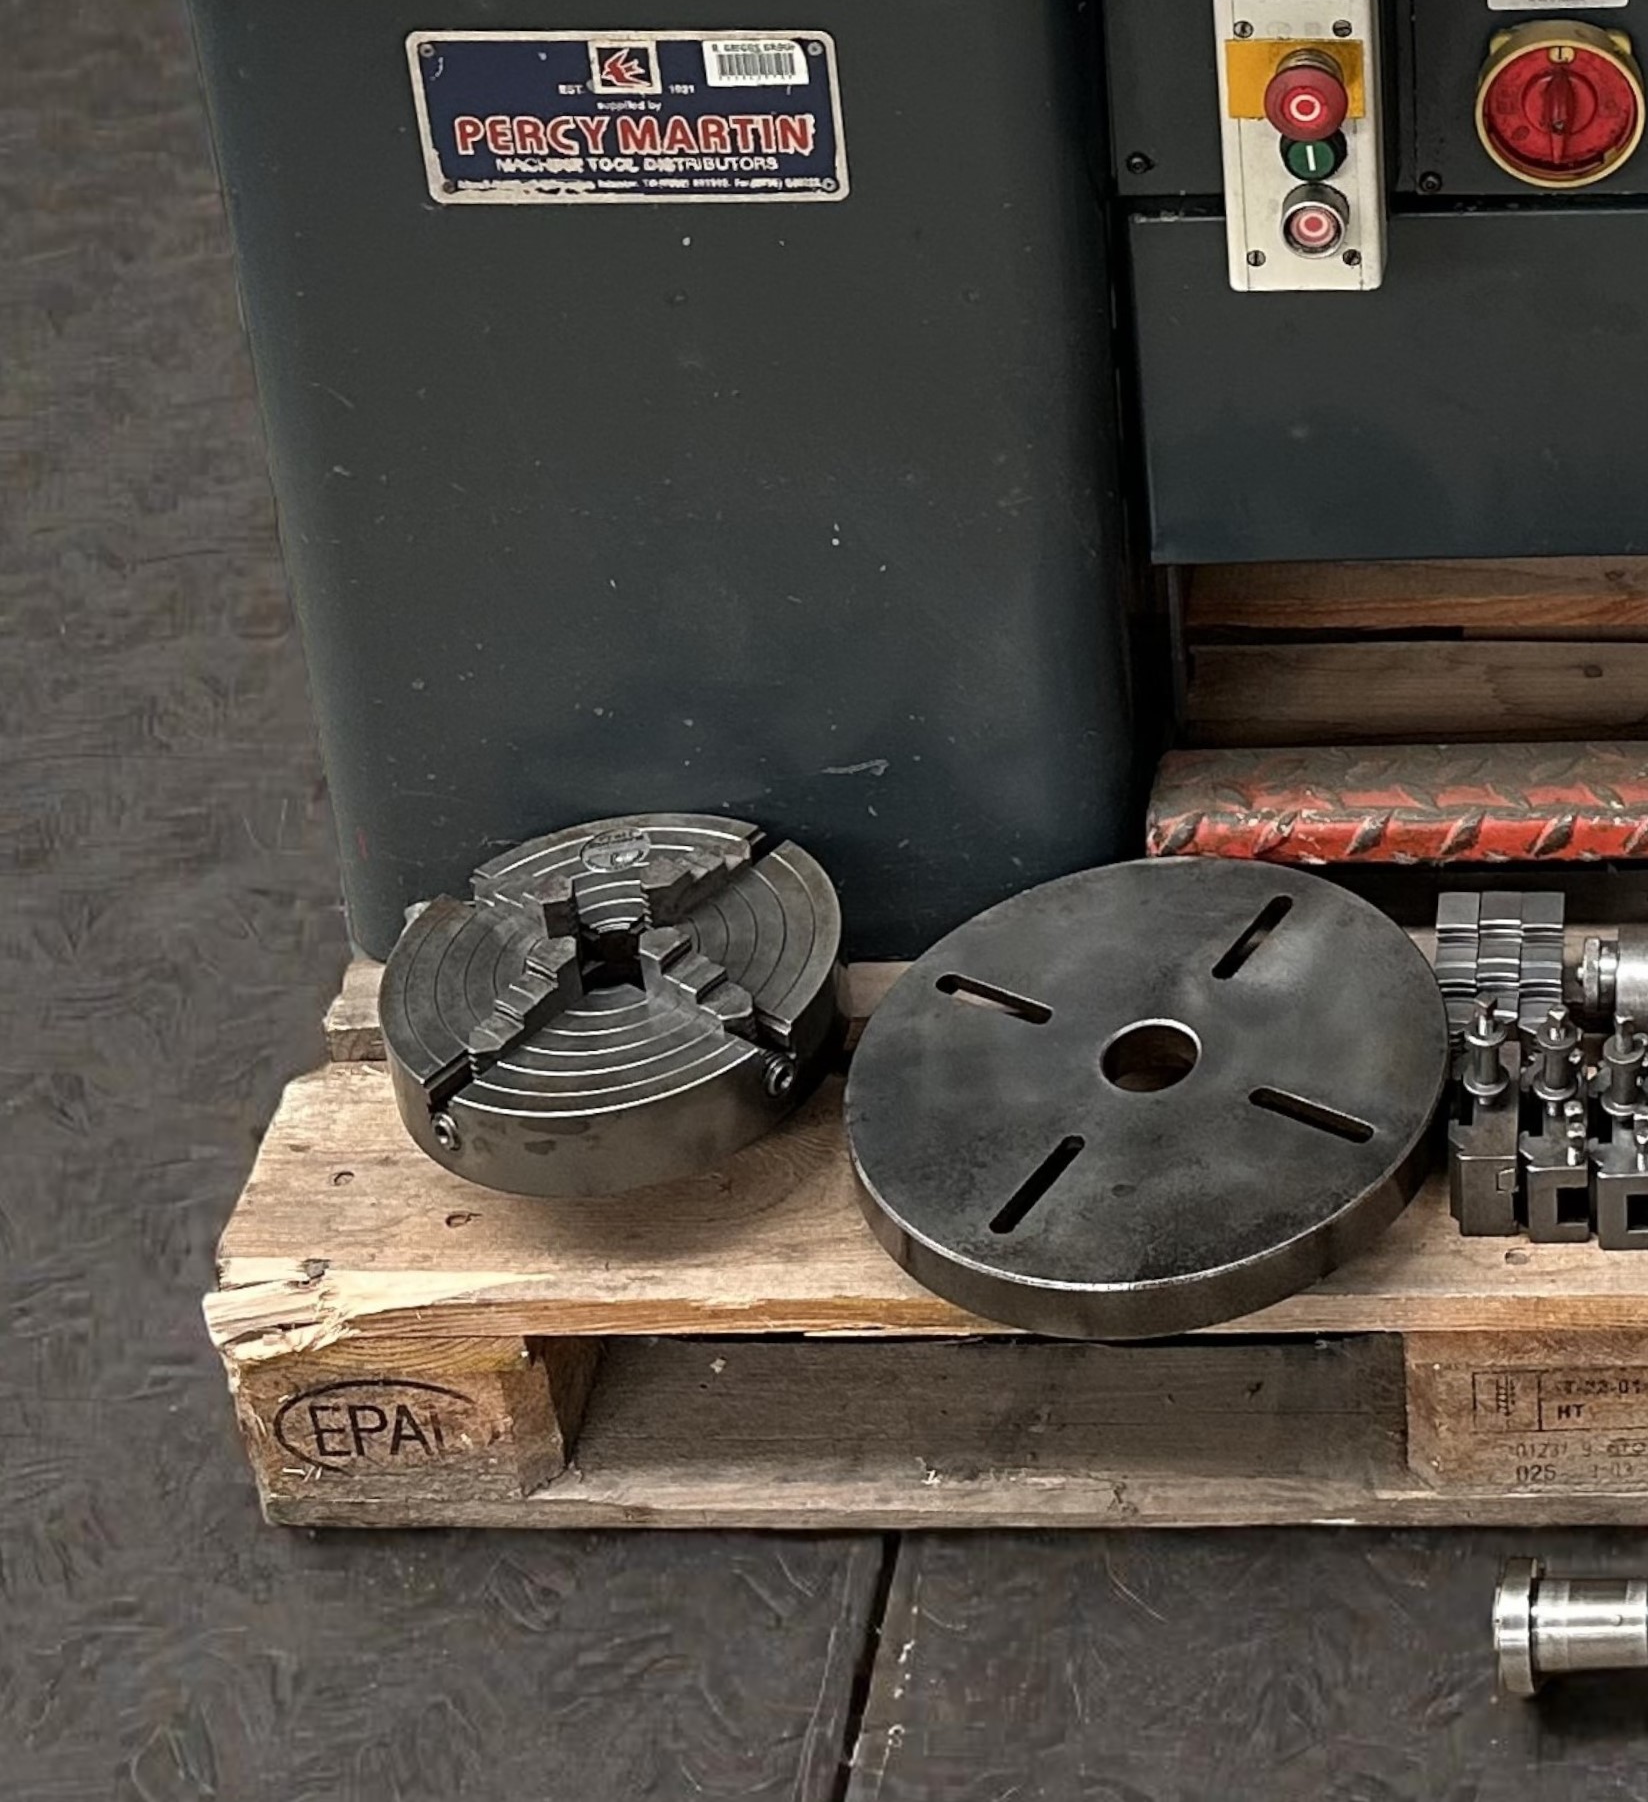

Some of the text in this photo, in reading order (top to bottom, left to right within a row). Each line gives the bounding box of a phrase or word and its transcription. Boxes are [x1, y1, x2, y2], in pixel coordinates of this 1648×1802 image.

[648, 101, 662, 112] by
[454, 113, 816, 156] PERCY MARTIN
[643, 156, 779, 172] DISTRIBUTORS
[1558, 1404, 1585, 1420] HT
